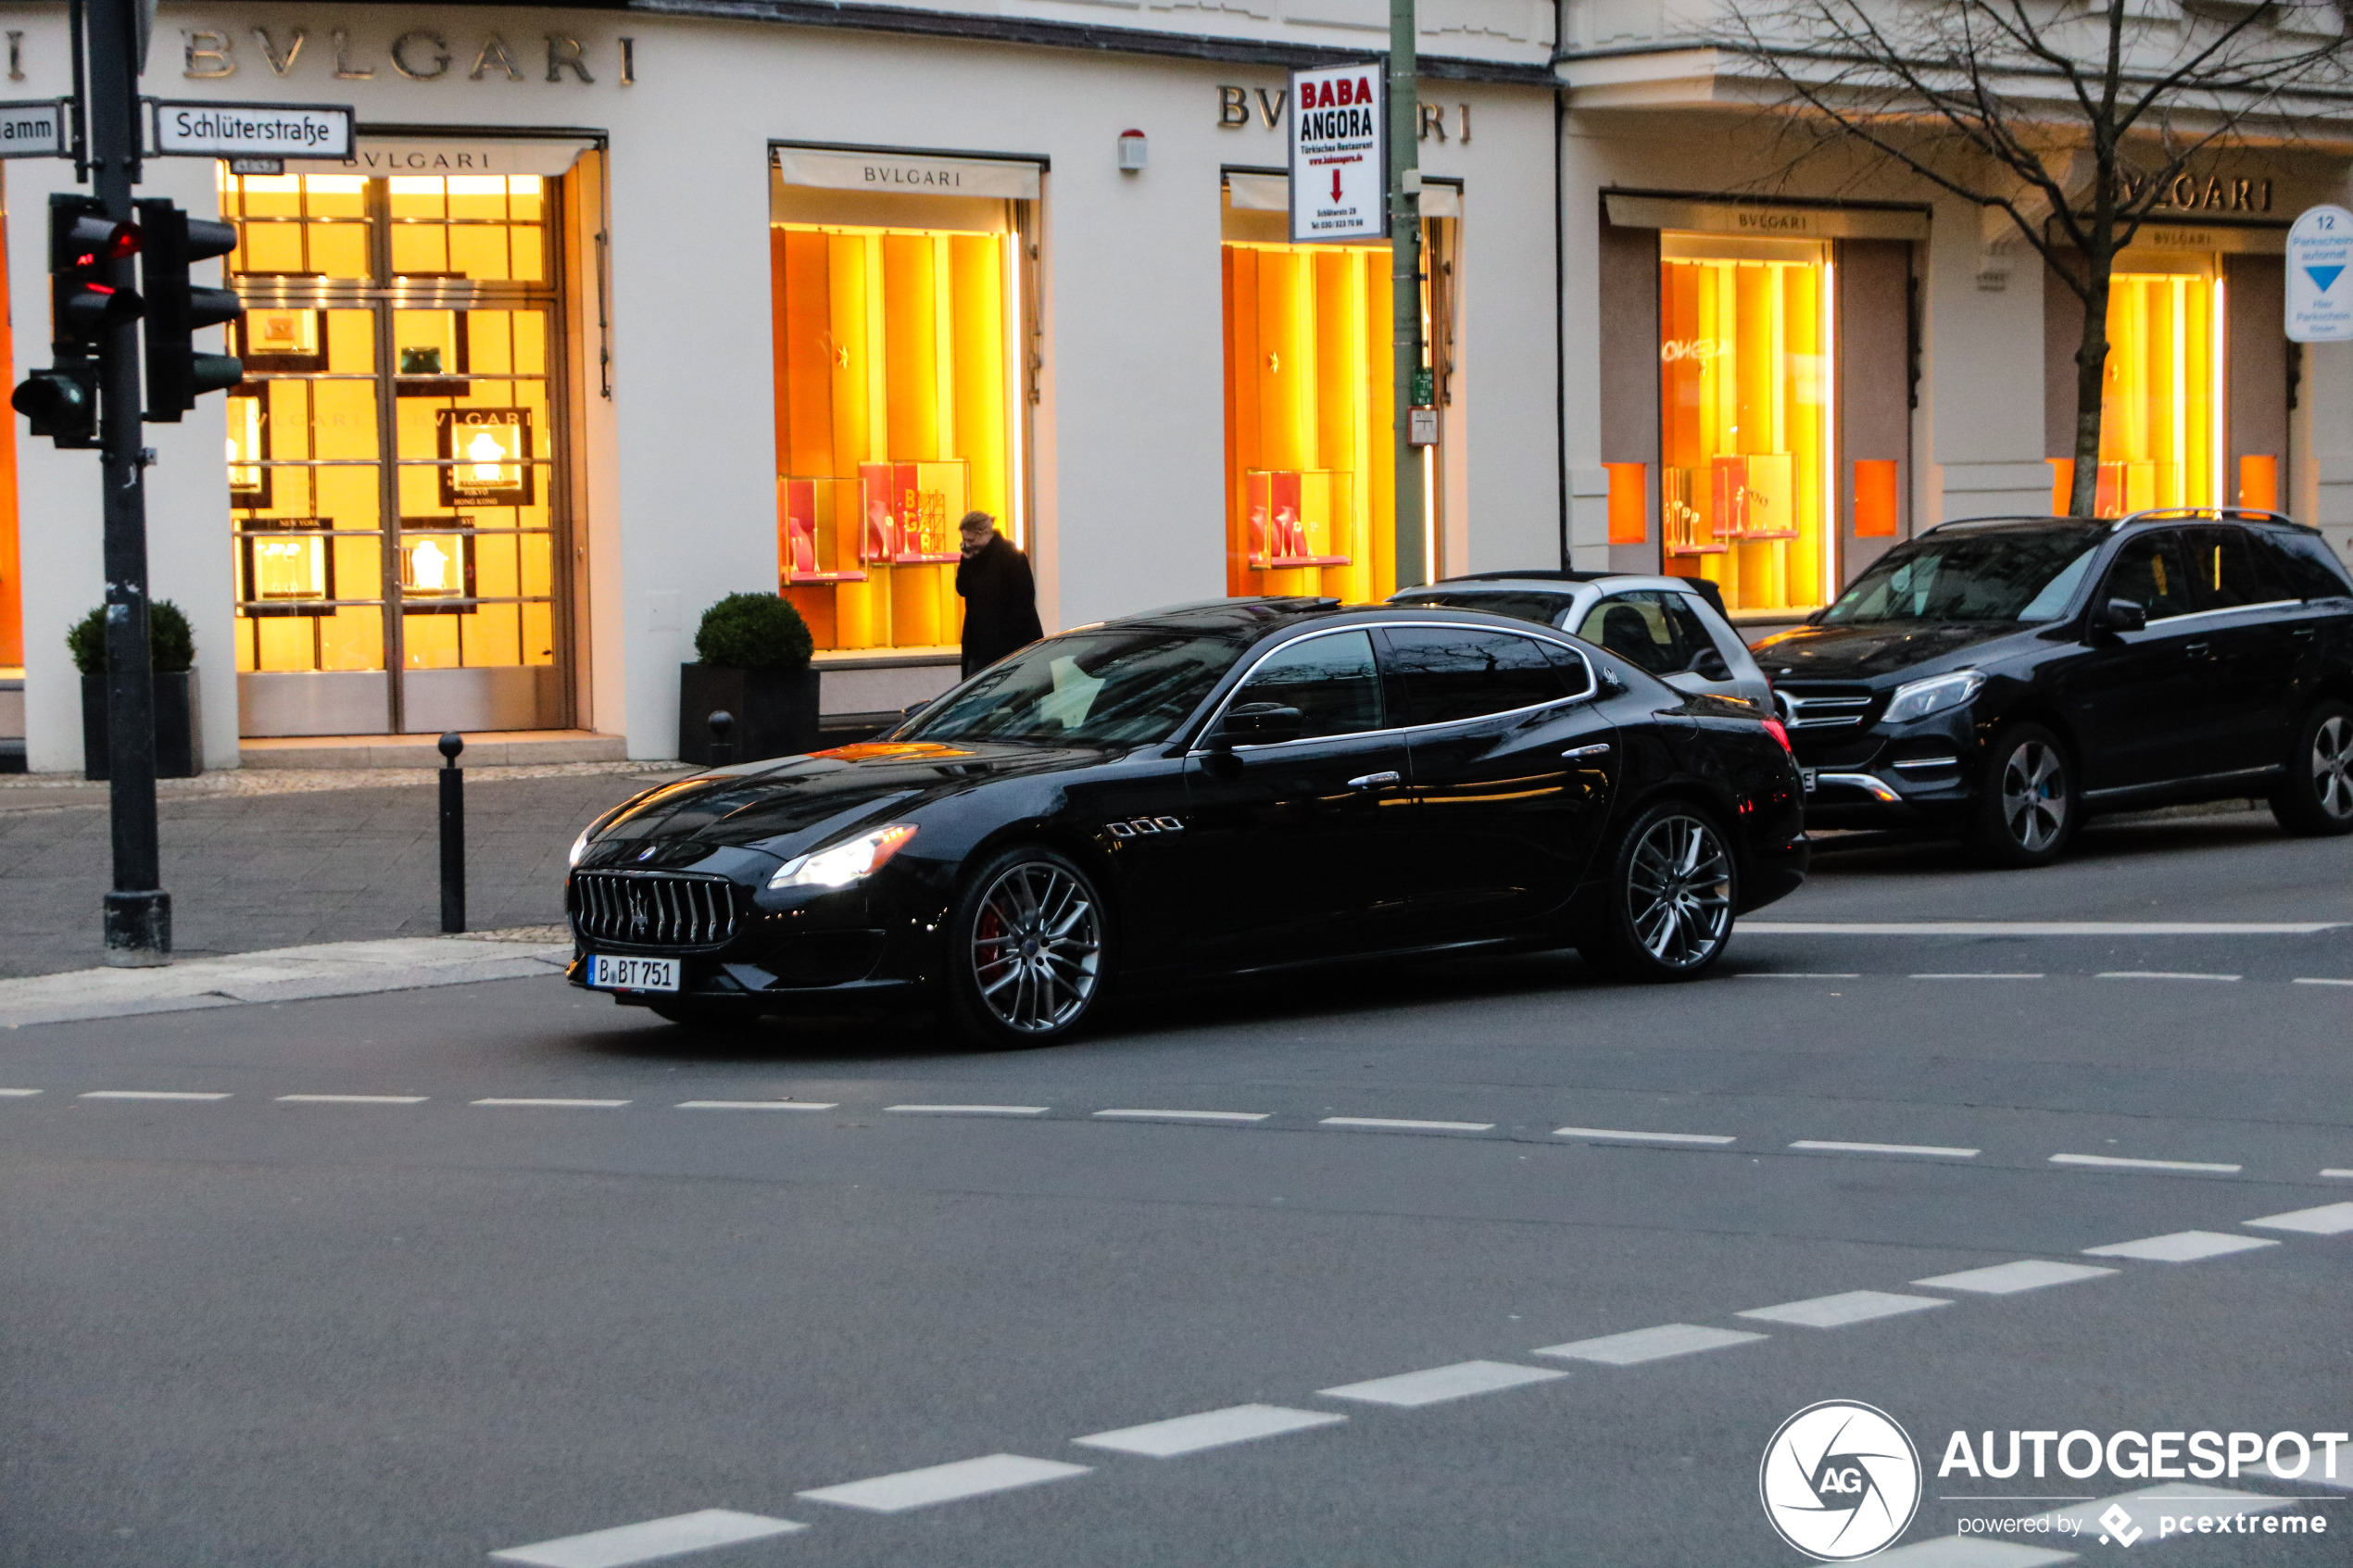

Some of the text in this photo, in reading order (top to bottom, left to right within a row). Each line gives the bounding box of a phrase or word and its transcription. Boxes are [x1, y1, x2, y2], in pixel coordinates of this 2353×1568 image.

[182, 27, 635, 86] BVLGARI
[1301, 77, 1373, 109] BABA
[1215, 84, 1471, 144] BVRI
[1301, 107, 1373, 142] ANGORA
[0, 121, 52, 139] amm
[176, 112, 330, 145] Schlüterstraße
[864, 167, 960, 186] BVLGARI
[1739, 213, 1806, 229] BVLGARI
[2317, 215, 2334, 230] 12
[2154, 232, 2210, 245] BVLGARI
[599, 959, 671, 985] B BT 751
